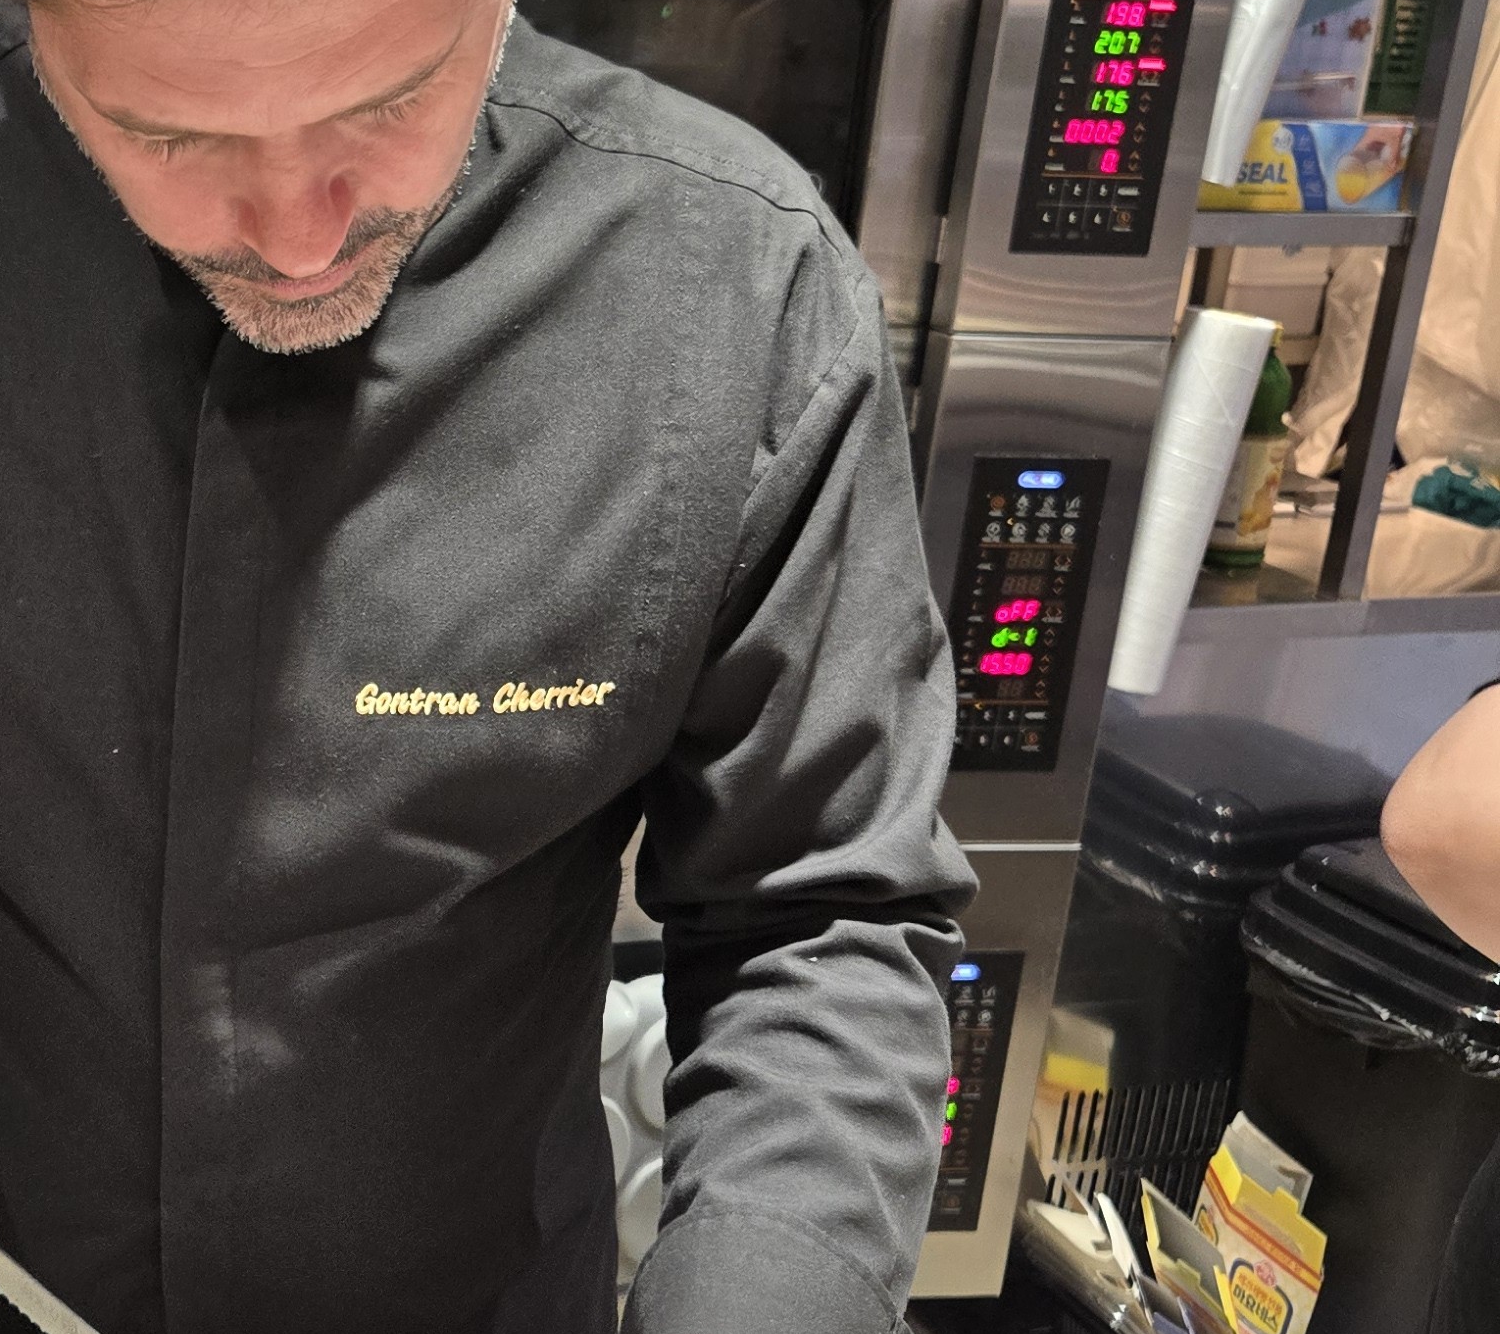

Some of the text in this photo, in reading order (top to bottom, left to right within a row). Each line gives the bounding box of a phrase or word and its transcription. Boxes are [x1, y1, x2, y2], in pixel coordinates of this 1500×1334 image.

[1094, 30, 1140, 54] 207
[1094, 59, 1135, 87] 176
[1090, 89, 1130, 114] 175
[1064, 118, 1126, 144] 0002
[1237, 161, 1288, 185] SEAL
[355, 677, 617, 716] Gontran Cherrier
